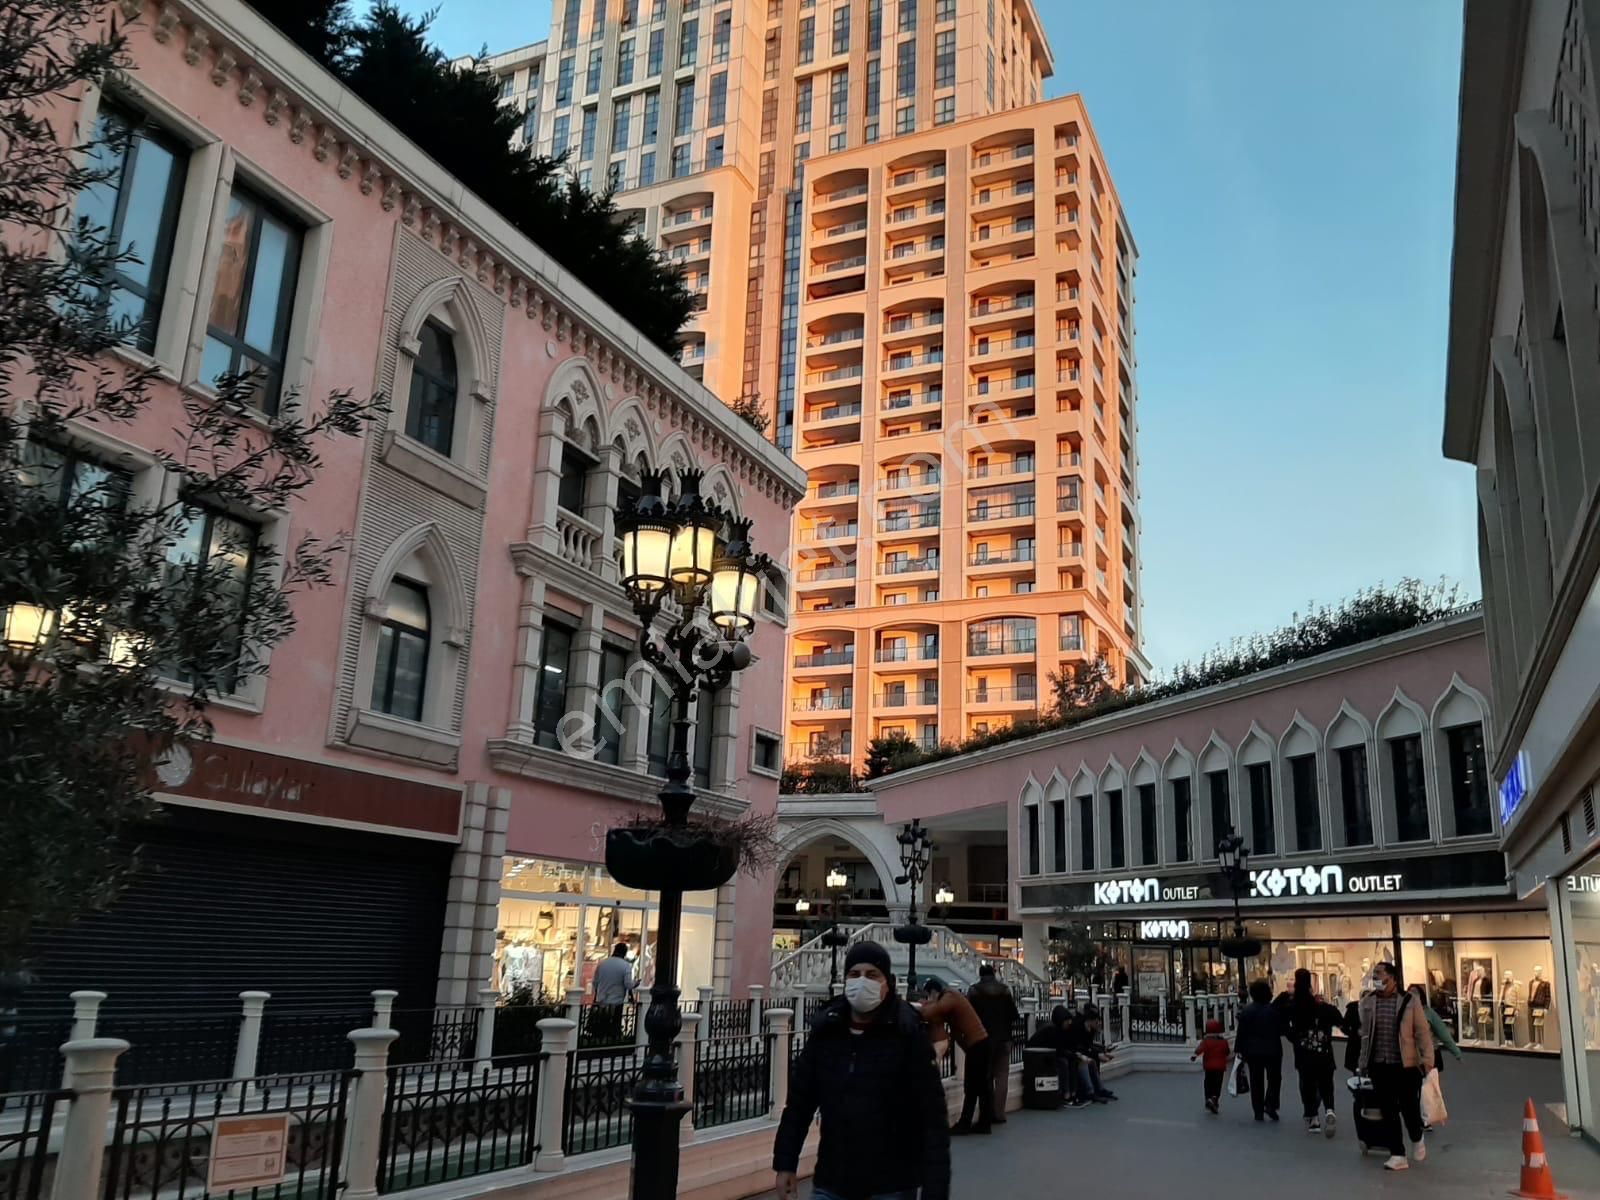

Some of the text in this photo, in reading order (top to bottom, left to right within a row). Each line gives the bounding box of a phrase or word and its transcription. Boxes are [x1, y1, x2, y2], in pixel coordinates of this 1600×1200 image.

[1094, 878, 1199, 904] KOTON OUTLET
[1250, 865, 1402, 897] KOTON OUTLET
[1141, 920, 1190, 939] KOTON
